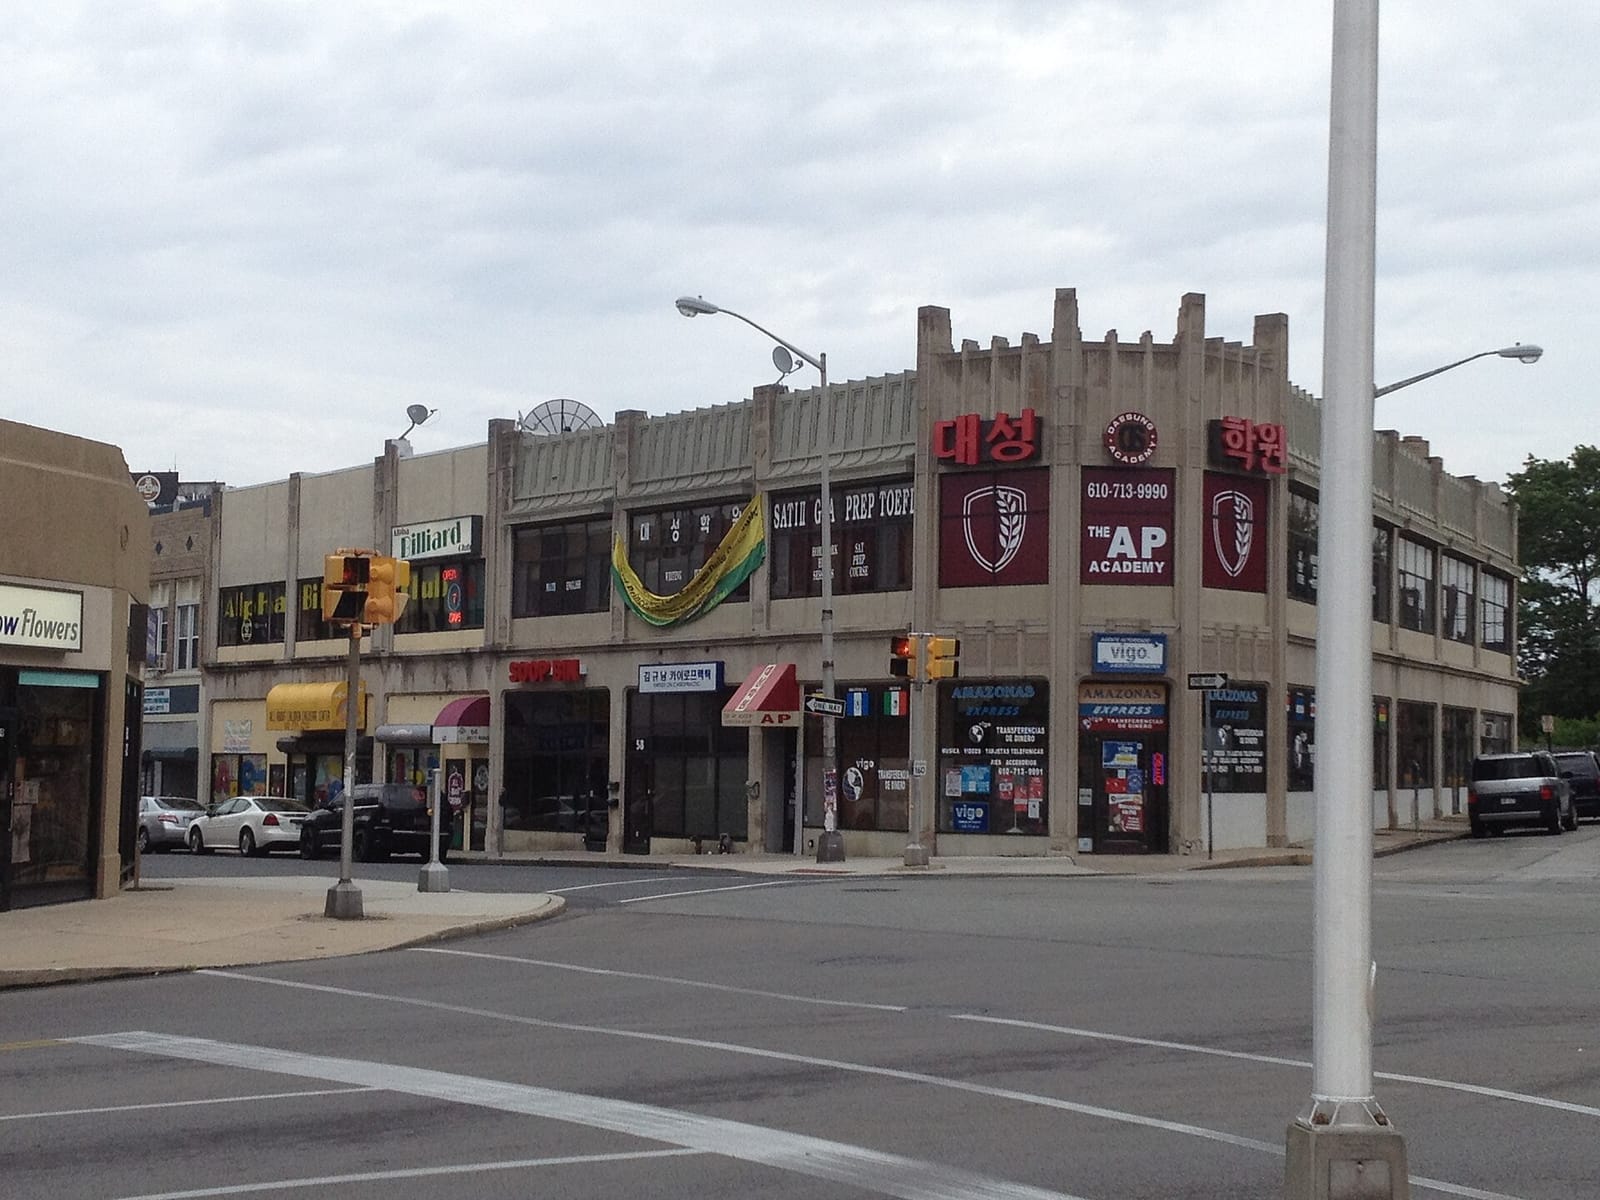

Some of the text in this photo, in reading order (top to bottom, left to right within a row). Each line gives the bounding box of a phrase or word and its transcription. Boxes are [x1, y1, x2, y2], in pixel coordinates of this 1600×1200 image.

[932, 408, 1035, 465] 대성
[1222, 416, 1288, 474] 학원
[1108, 441, 1156, 463] ACADEMY
[1087, 482, 1168, 499] 610-713-9990
[845, 493, 875, 521] PREP
[401, 520, 461, 558] Billiard
[1088, 526, 1167, 559] THE AP
[1089, 561, 1165, 573] ACADEMY
[21, 608, 78, 641] Flowers
[1111, 643, 1147, 662] vigo
[1083, 688, 1162, 699] AMAZONAS
[761, 714, 791, 724] AP
[1093, 705, 1153, 715] EXPRESS
[855, 757, 875, 771] vigo
[955, 803, 984, 821] vigo
